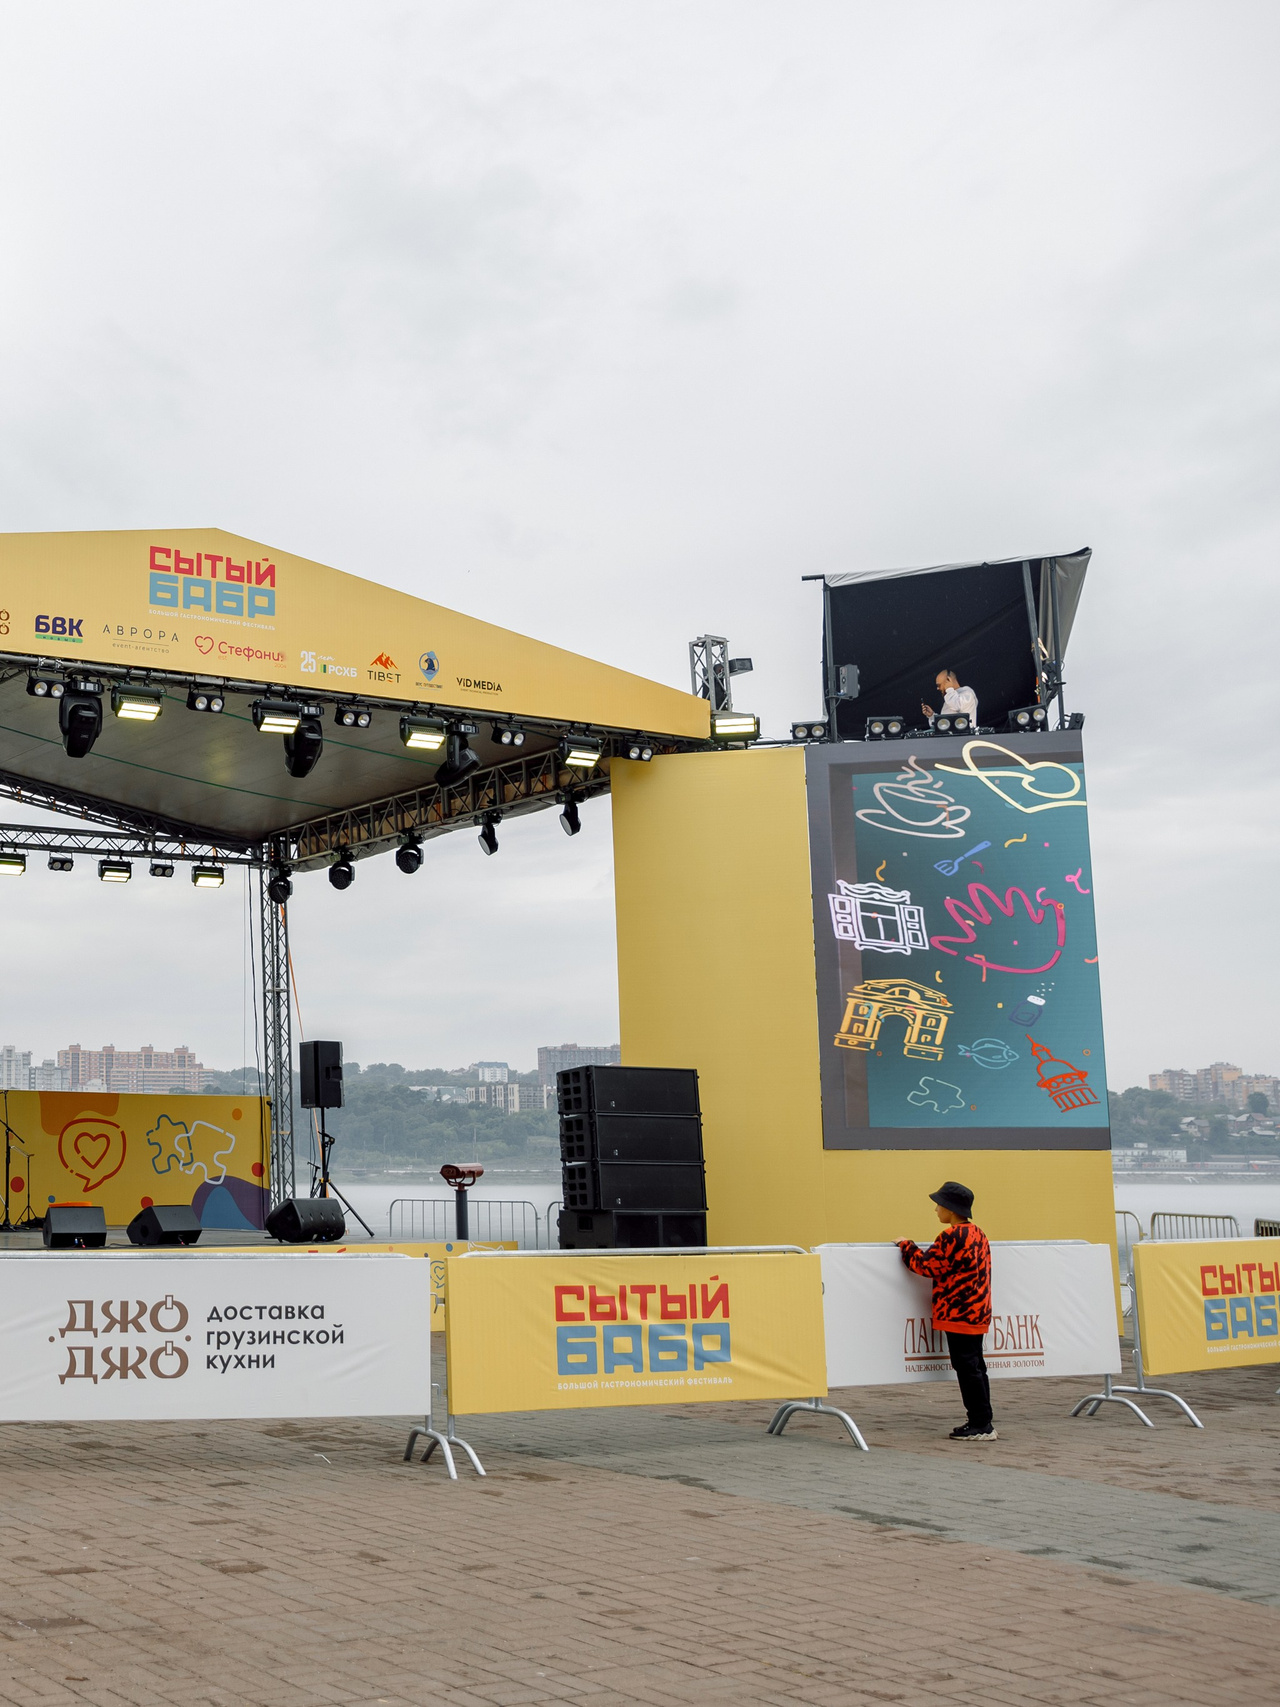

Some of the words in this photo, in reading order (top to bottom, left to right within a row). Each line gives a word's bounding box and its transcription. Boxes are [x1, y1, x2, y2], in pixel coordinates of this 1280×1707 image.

[149, 545, 276, 588] СЫТЫЙ
[148, 572, 276, 619] БАБР
[34, 614, 84, 637] БВК
[148, 609, 179, 618] БОЛЬШОЙ
[180, 612, 241, 626] ГАСТРОНОМИЧЕСКИЙ
[242, 621, 276, 631] ФЕСТИВАЛЬ
[102, 624, 179, 642] АВРОРА
[218, 641, 285, 662] Стефани
[300, 650, 316, 673] 25
[328, 664, 358, 678] РСХБ
[1200, 1261, 1280, 1296] СЫТЫ
[553, 1274, 730, 1322] СЫТЫЙ
[58, 1294, 189, 1338] ДЖО
[206, 1305, 325, 1322] доставка
[1204, 1294, 1280, 1341] БАБ
[206, 1324, 345, 1350] грузинской
[556, 1322, 732, 1376] БАБР
[1206, 1344, 1230, 1354] БОЛЬШОЙ
[58, 1340, 189, 1385] ДЖО
[206, 1353, 276, 1374] кухни
[1012, 1359, 1045, 1368] ЗОЛОТОМ
[557, 1380, 599, 1390] БОЛЬШОЙ
[600, 1378, 685, 1389] ГАСТРОНОМИЧЕСКИЙ
[686, 1376, 733, 1386] ФЕСТИВАЛЬ
